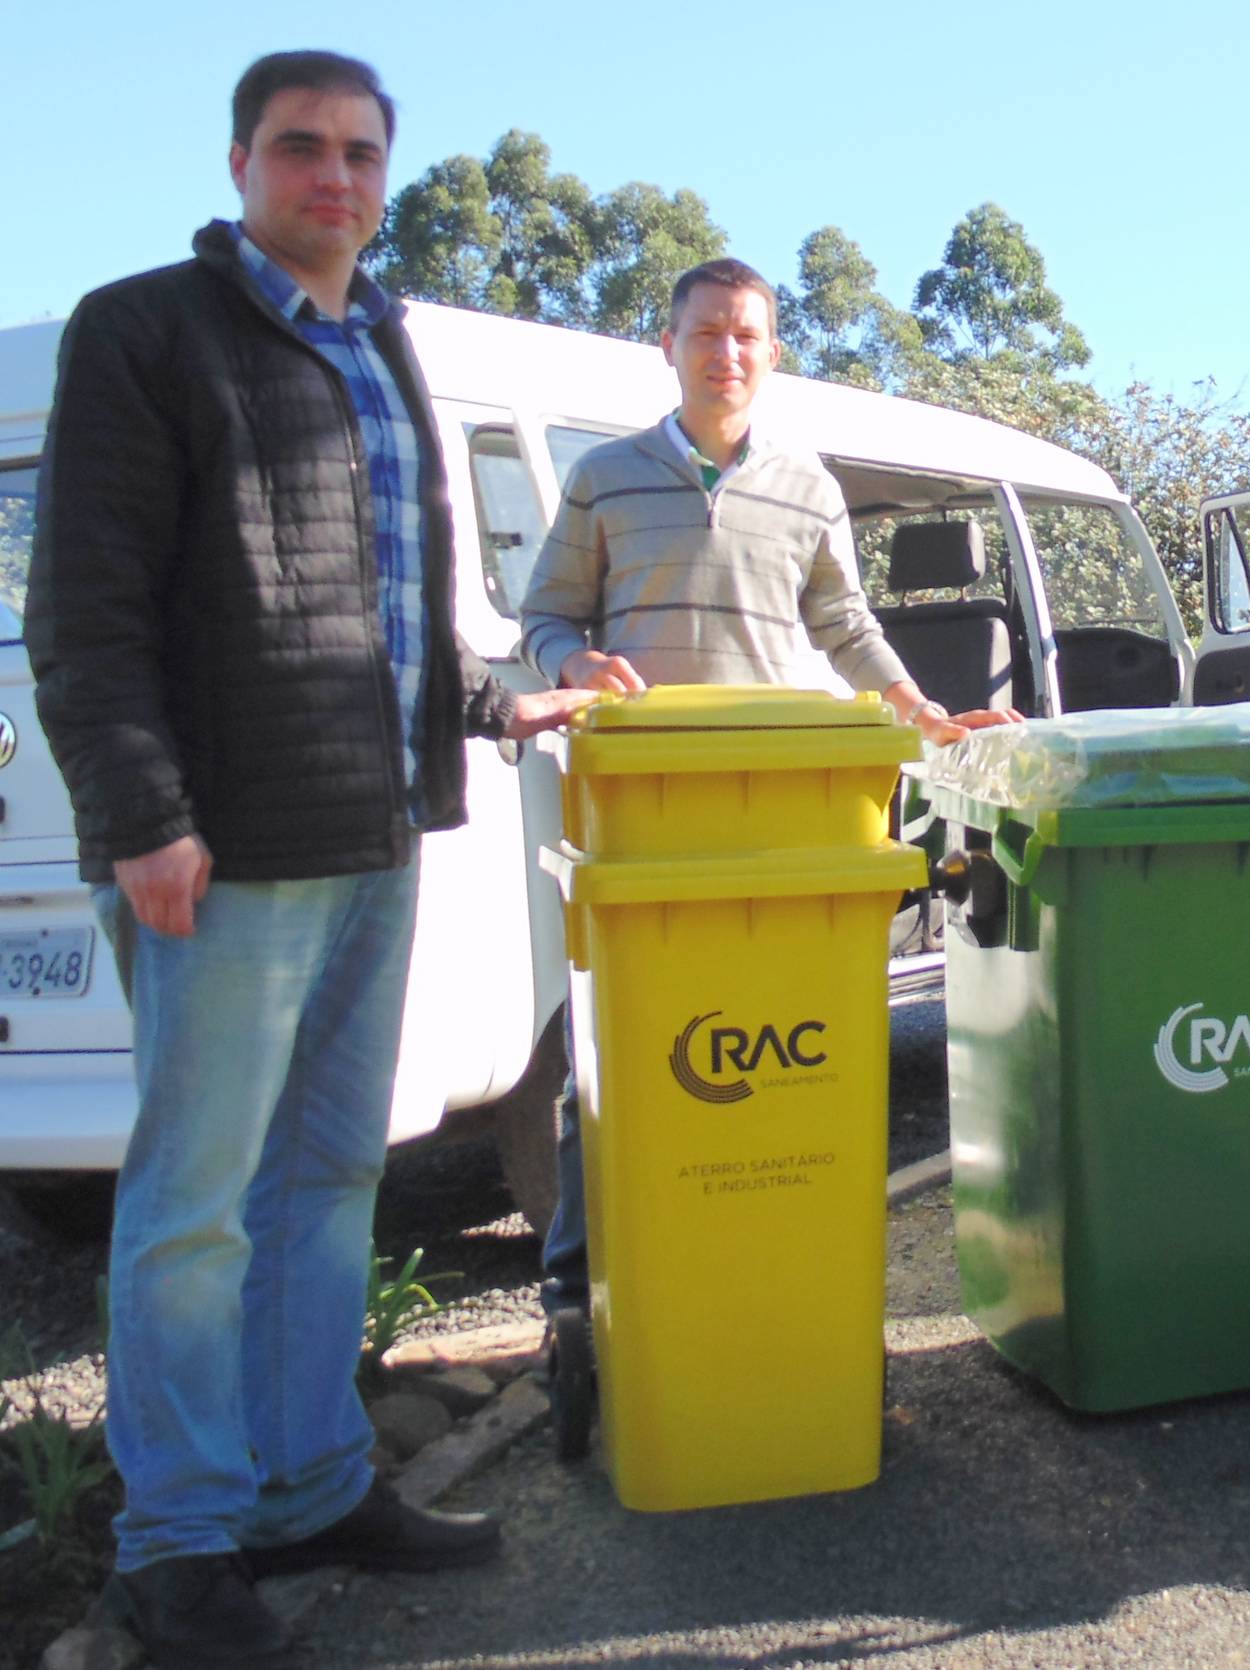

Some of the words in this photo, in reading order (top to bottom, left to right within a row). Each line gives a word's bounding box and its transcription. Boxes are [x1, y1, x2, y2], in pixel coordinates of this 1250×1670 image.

[678, 1161, 745, 1178] ATERRO
[703, 1181, 713, 1195] E
[718, 1173, 813, 1193] INDUSTRIAL
